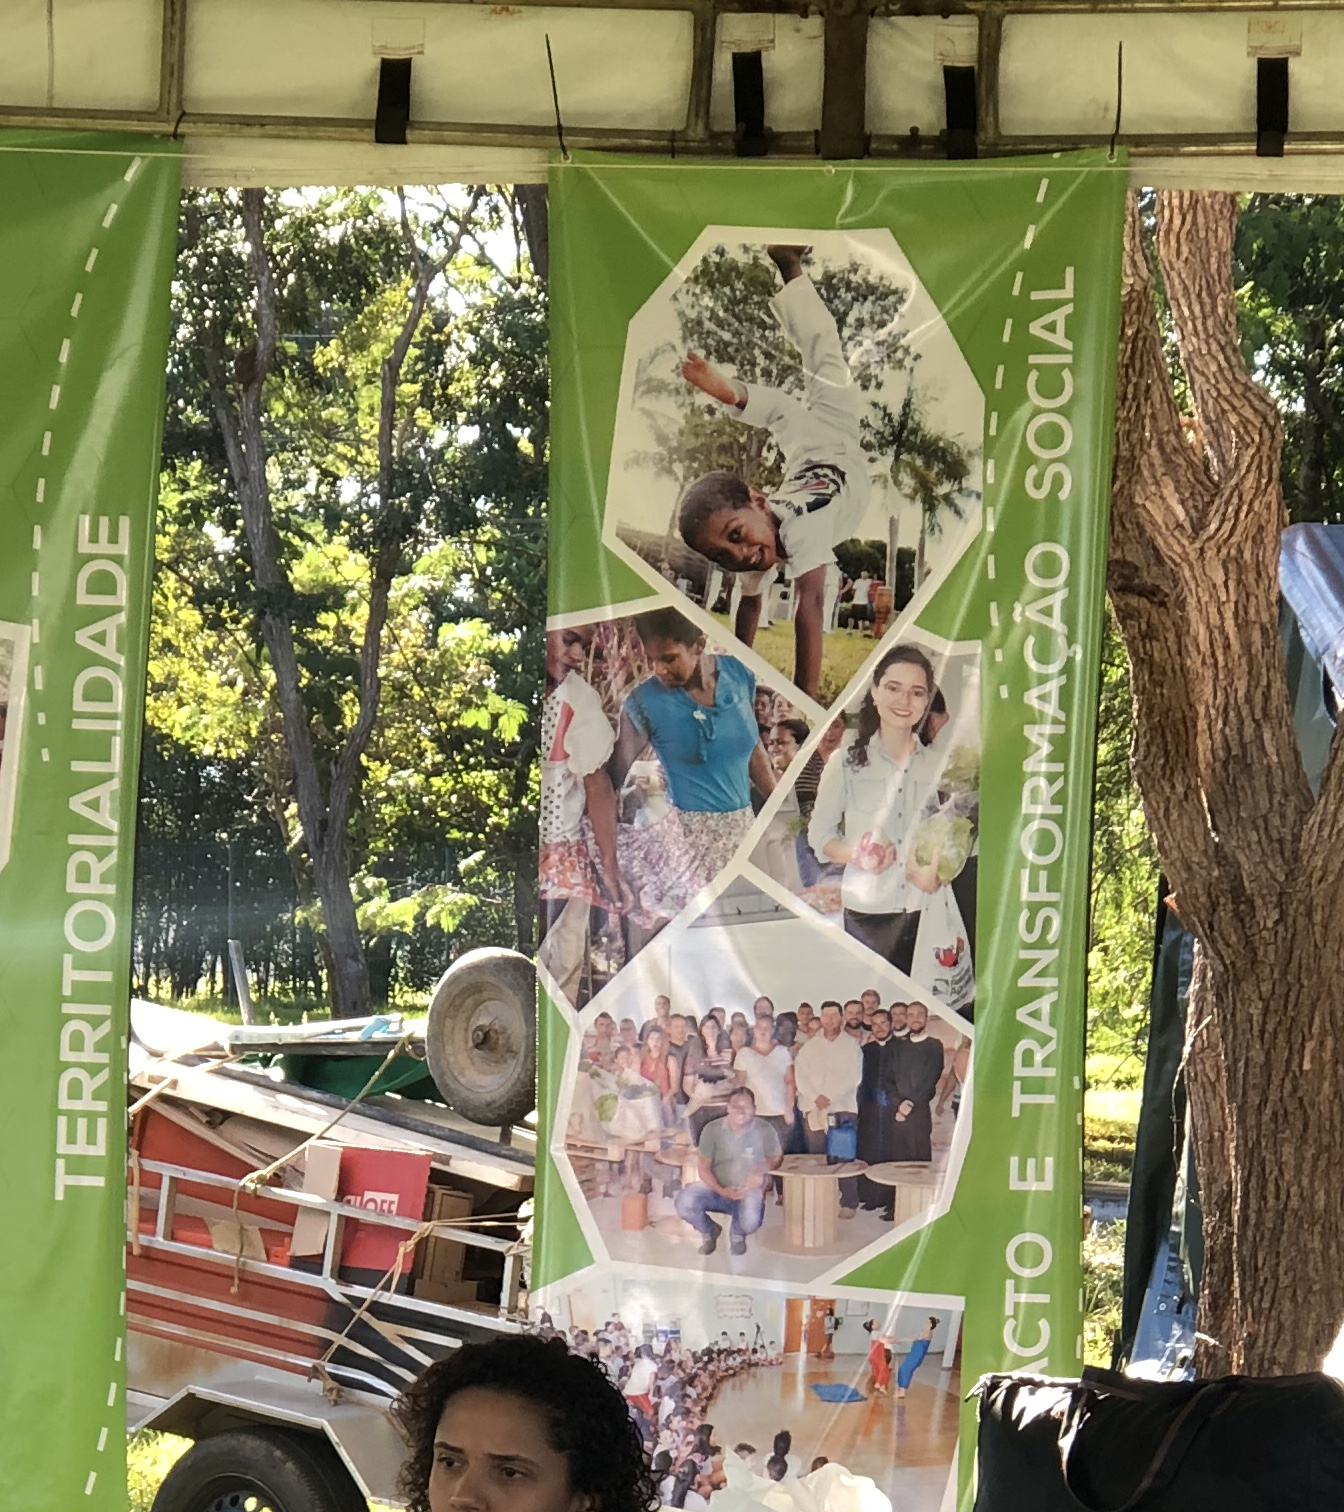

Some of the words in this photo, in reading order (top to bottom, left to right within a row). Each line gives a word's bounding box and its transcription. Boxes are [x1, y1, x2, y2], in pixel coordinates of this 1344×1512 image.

[1025, 265, 1075, 501] SOCIAL
[55, 513, 130, 1200] TERRITORIALIDADE
[1012, 541, 1081, 1119] TRANSFORMAÇÃO
[1009, 1156, 1053, 1192] E
